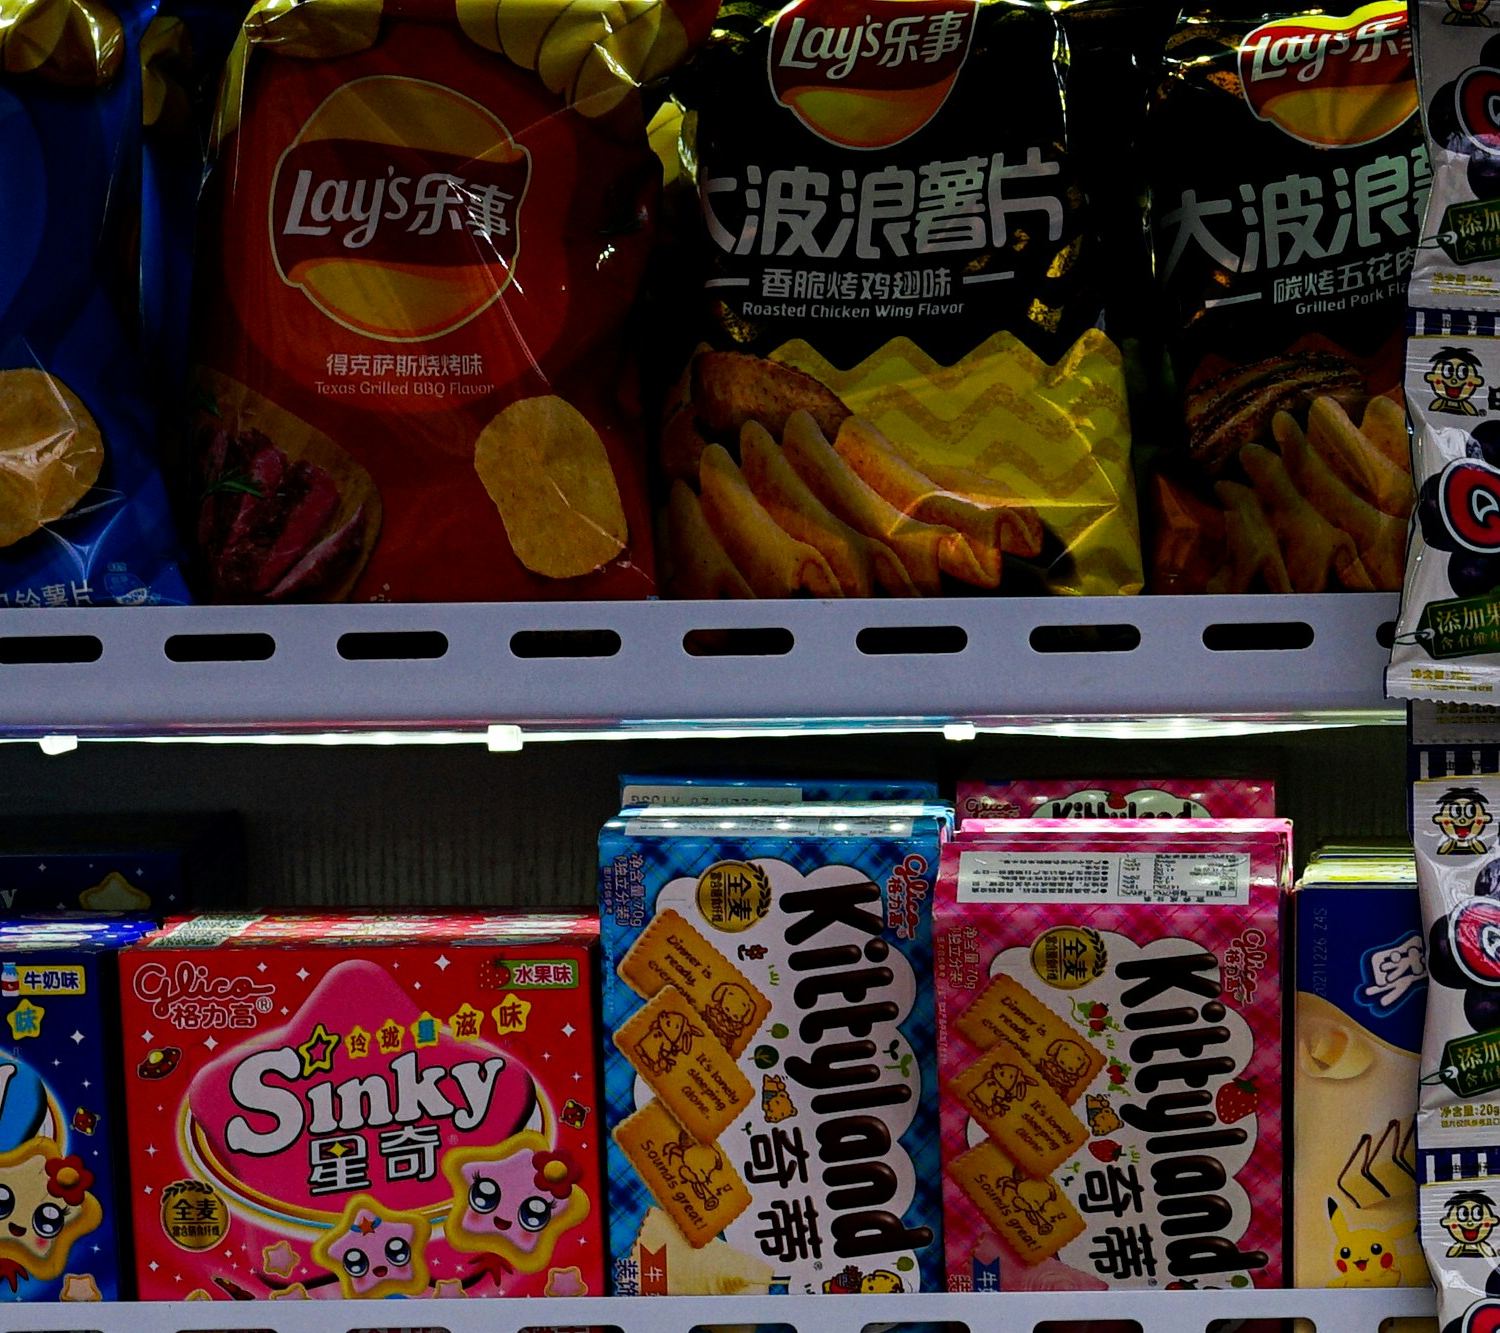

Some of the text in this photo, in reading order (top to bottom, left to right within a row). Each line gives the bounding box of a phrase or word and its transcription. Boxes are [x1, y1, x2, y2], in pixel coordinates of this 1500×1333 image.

[283, 167, 514, 248] Lay's乐事
[762, 269, 952, 301] 香脆烤鸡翅味
[743, 300, 963, 320] Roasted Chicken Wing Flavor
[326, 353, 483, 378] 得克萨斯烧烤味
[315, 380, 494, 397] Texas Grilled BBQ Flavor
[23, 966, 83, 993] 牛奶味
[511, 961, 573, 987] 水果味
[779, 880, 935, 1263] Kittyland
[227, 1046, 506, 1157] Sinky
